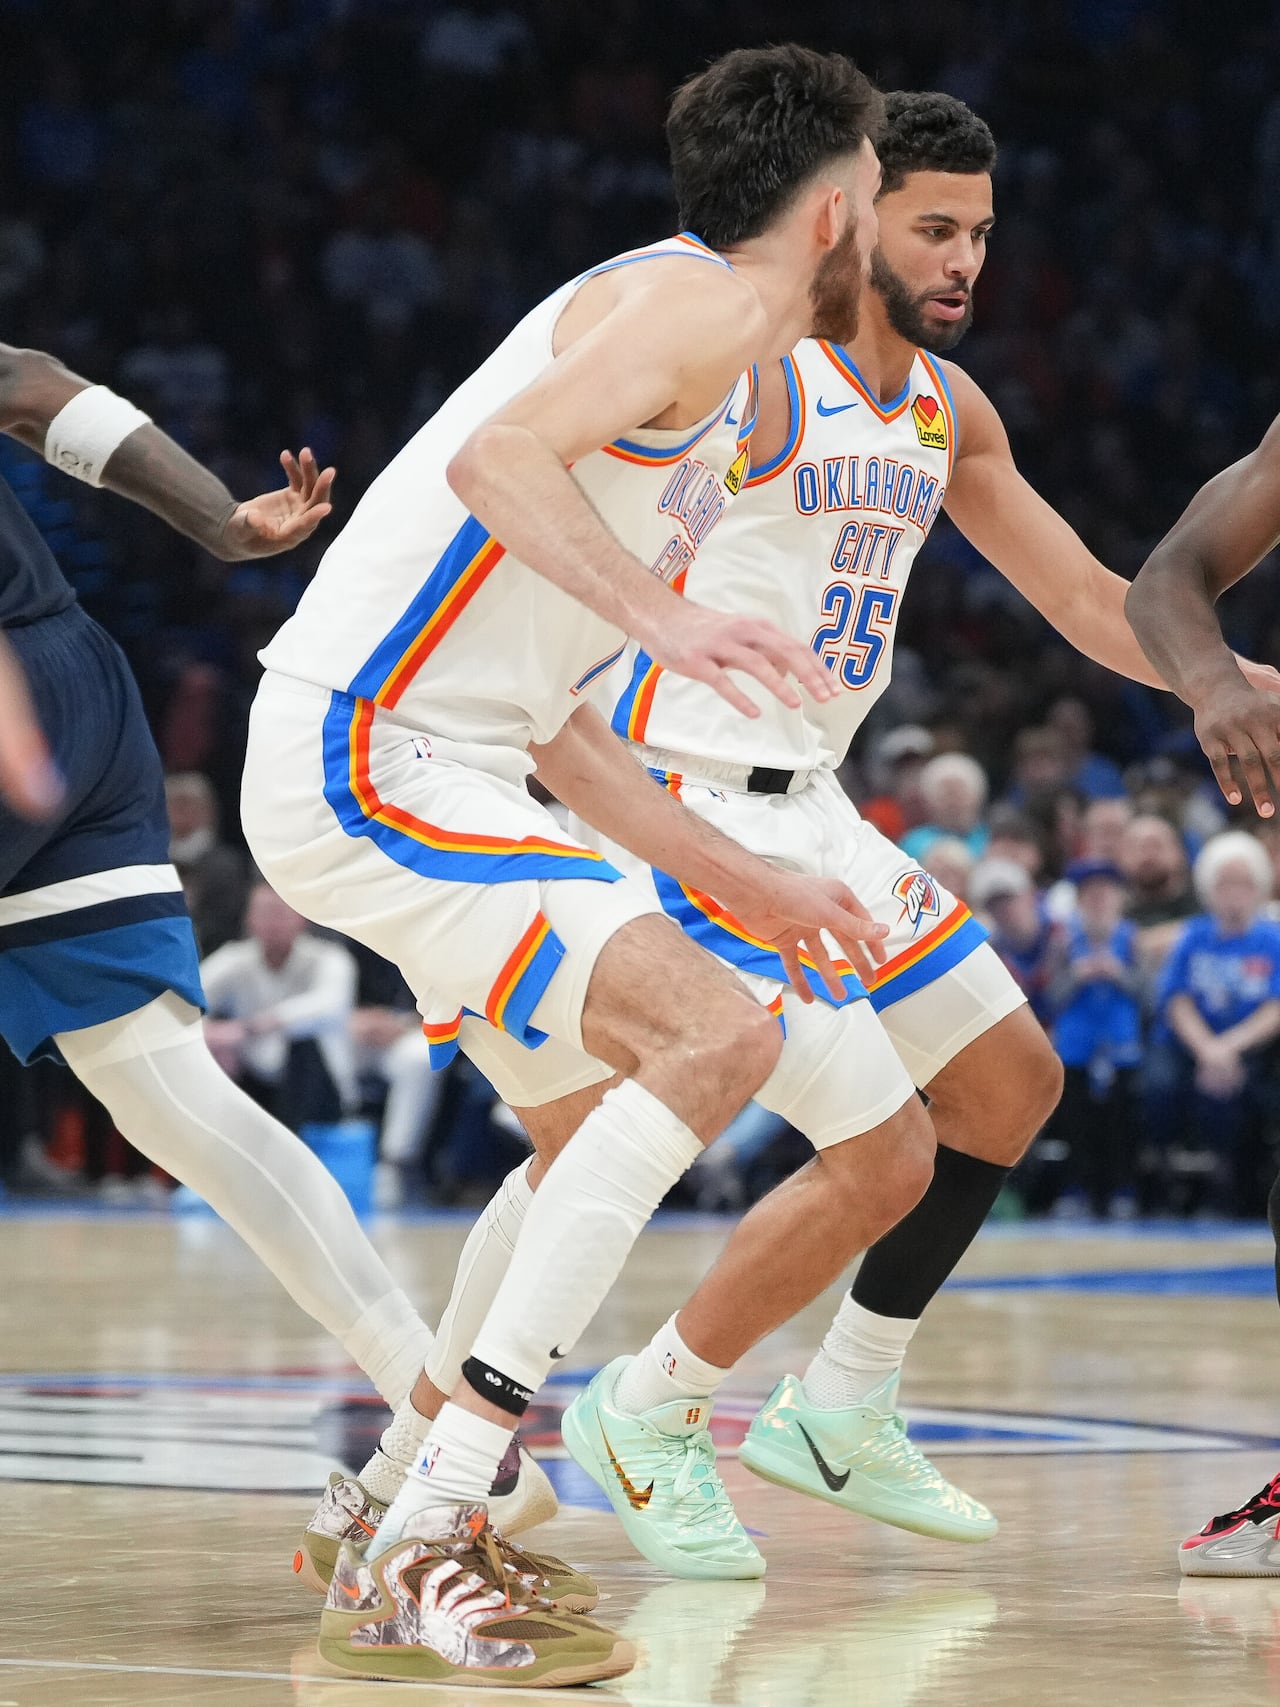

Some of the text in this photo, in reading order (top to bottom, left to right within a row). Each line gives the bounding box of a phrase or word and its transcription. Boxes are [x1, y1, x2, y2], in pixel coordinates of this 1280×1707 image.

[657, 457, 726, 550] OKLAHO
[831, 520, 905, 580] CITY
[809, 580, 899, 691] 25
